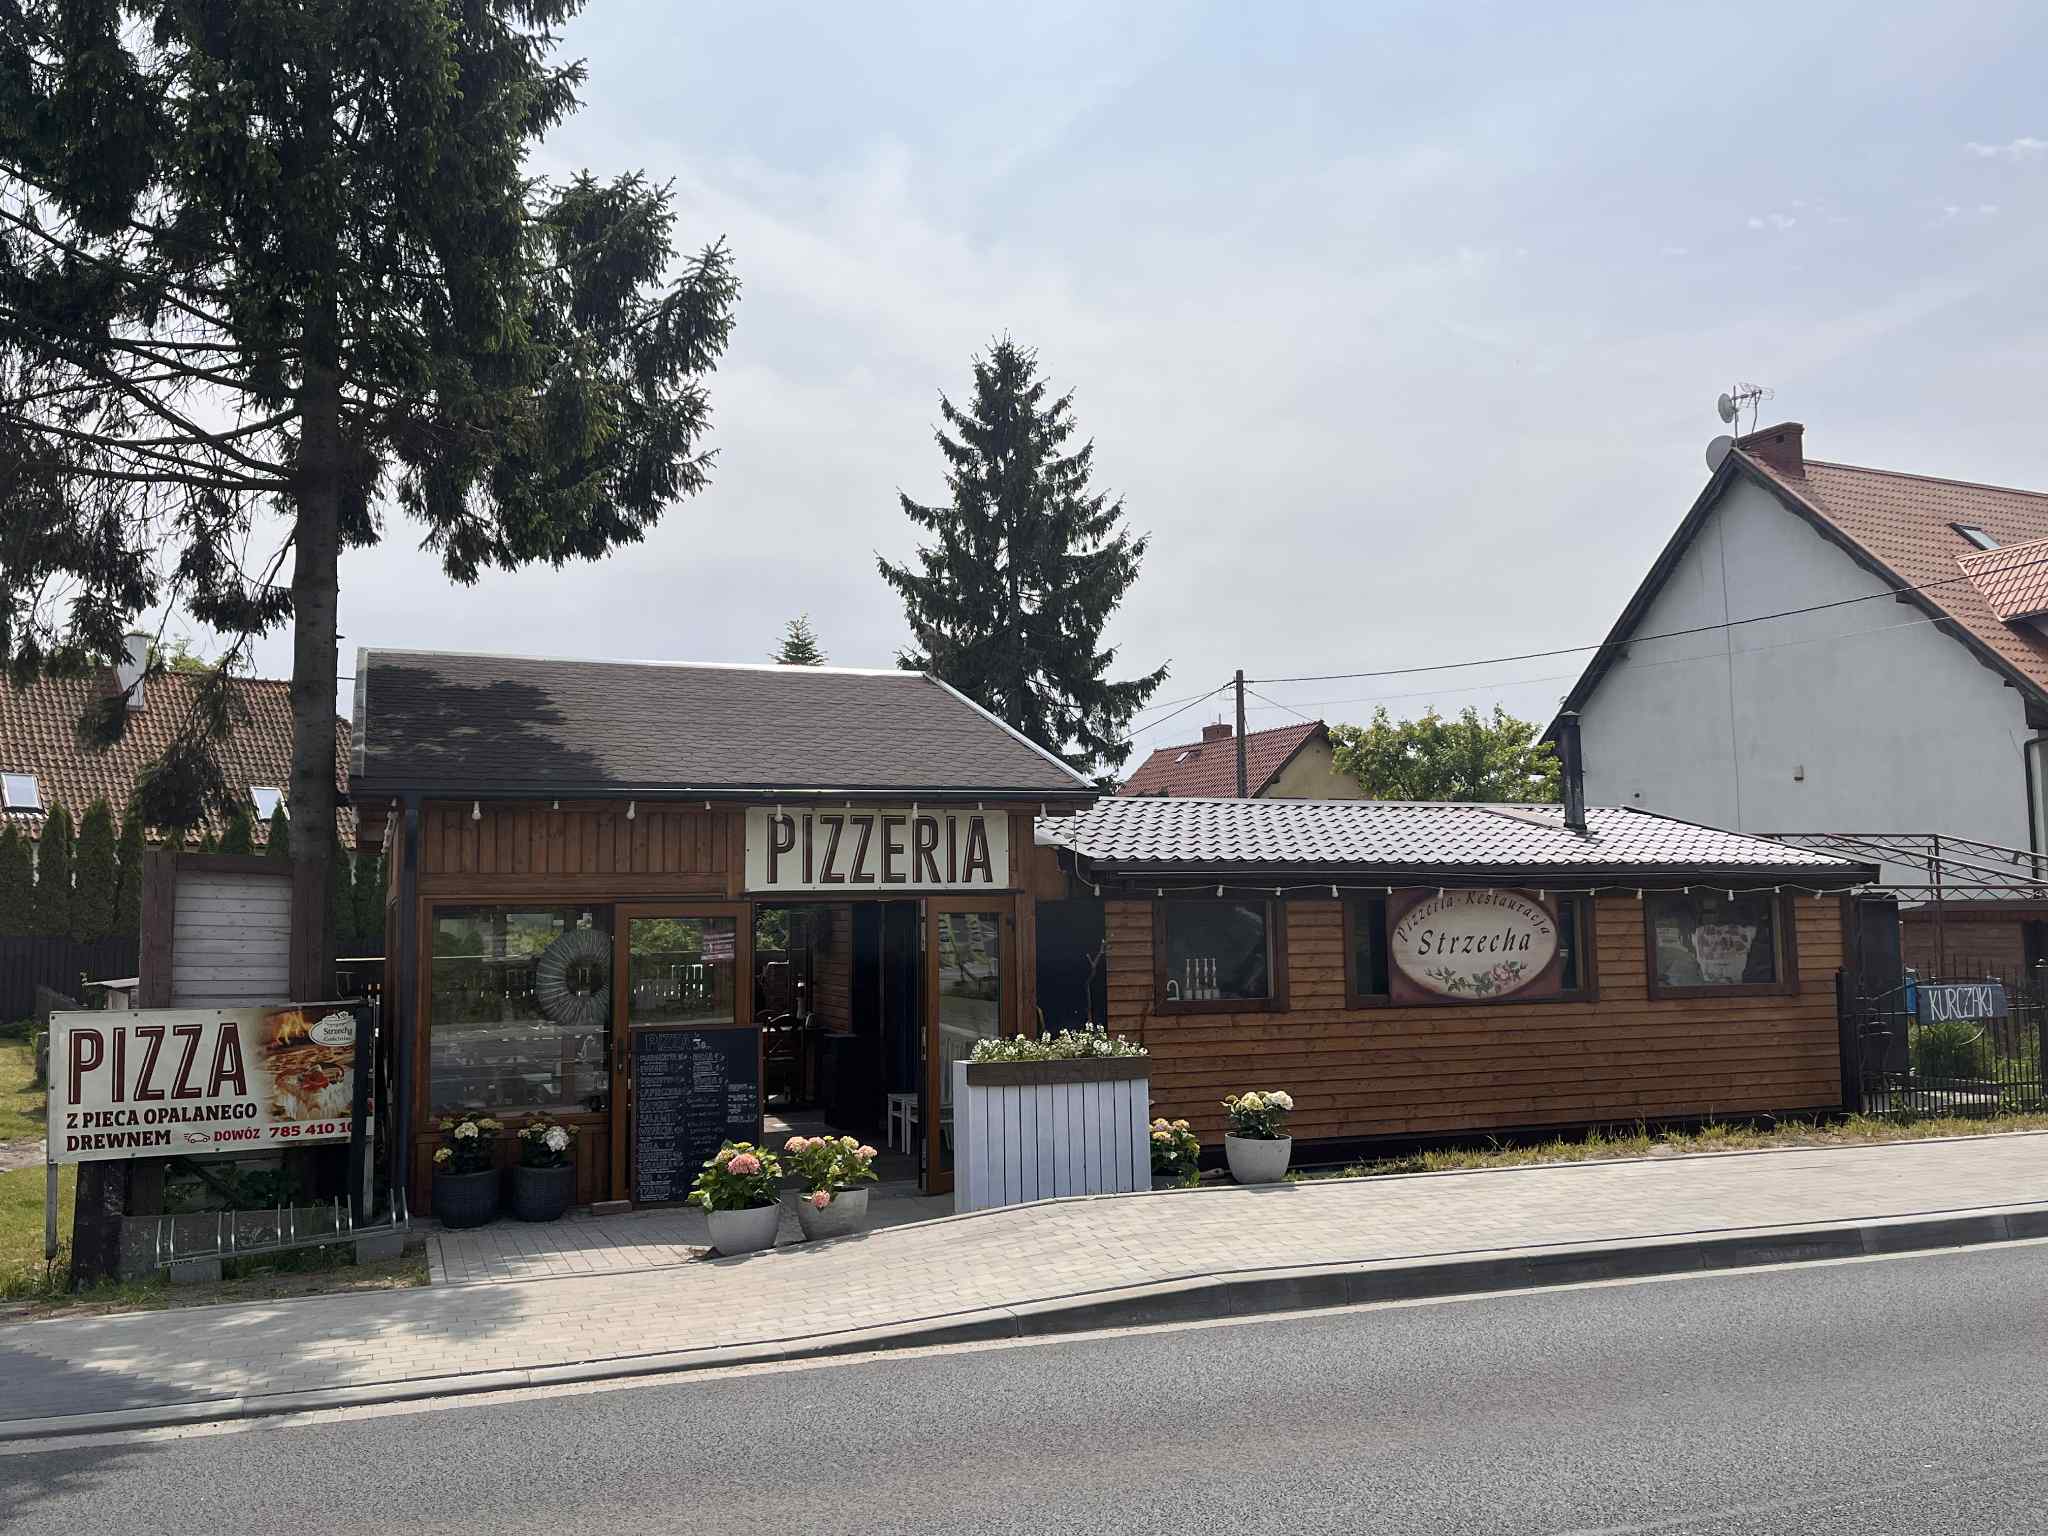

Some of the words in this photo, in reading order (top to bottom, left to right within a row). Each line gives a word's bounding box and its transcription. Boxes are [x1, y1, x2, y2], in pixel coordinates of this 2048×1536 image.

[766, 813, 993, 884] PIZZERIA
[1397, 895, 1454, 943] Pizzeria
[1464, 888, 1551, 935] Restauracja
[1417, 927, 1532, 956] Strzecha
[67, 1022, 248, 1105] PIZZA
[66, 1112, 79, 1129] Z
[82, 1109, 140, 1129] PIECA
[143, 1102, 258, 1125] OPALANEGO
[66, 1130, 172, 1152] DREWNEM
[213, 1126, 261, 1142] DOWÓZ
[269, 1125, 301, 1138] 785
[304, 1122, 336, 1135] 410
